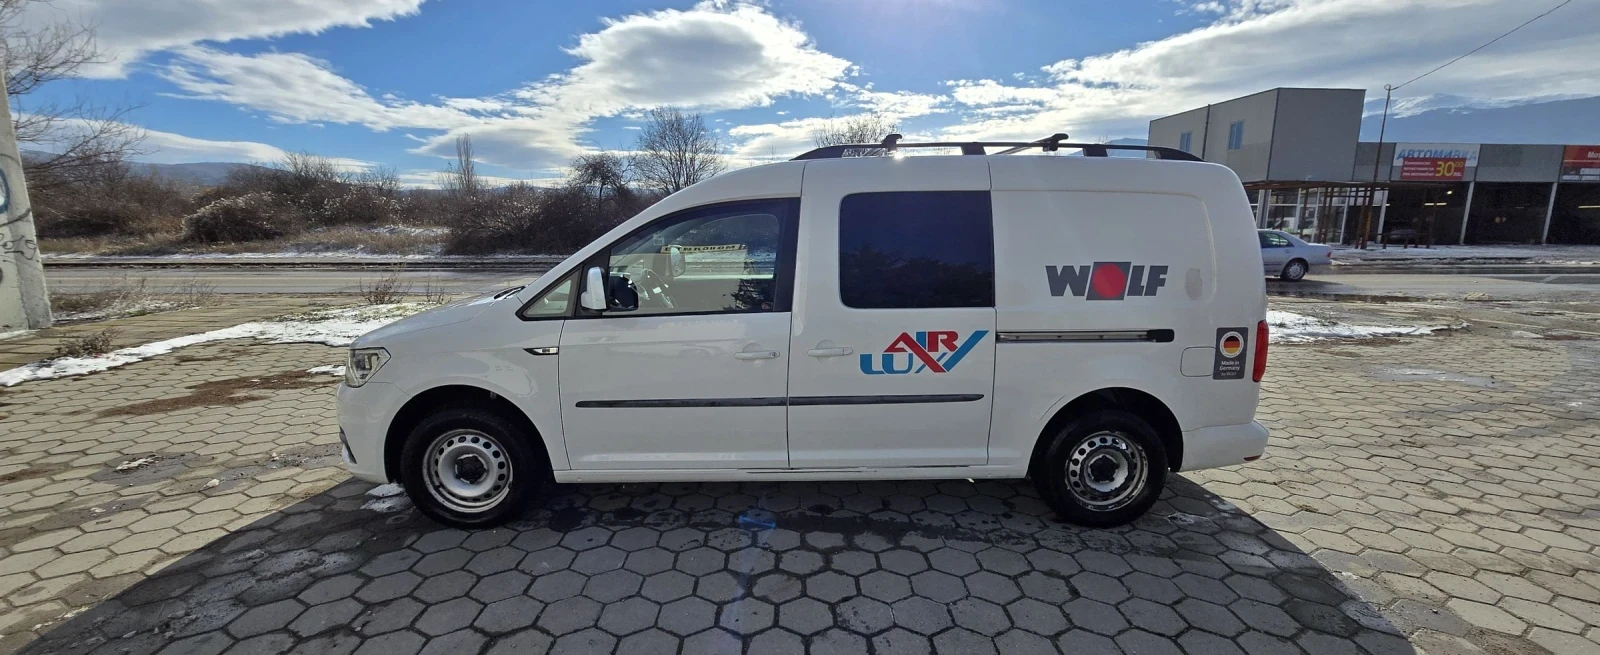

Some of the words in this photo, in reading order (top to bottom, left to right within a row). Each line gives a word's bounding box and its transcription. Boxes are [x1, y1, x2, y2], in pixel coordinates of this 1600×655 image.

[1435, 161, 1455, 177] 30
[1045, 262, 1169, 300] WOLF
[883, 330, 959, 352] AIR
